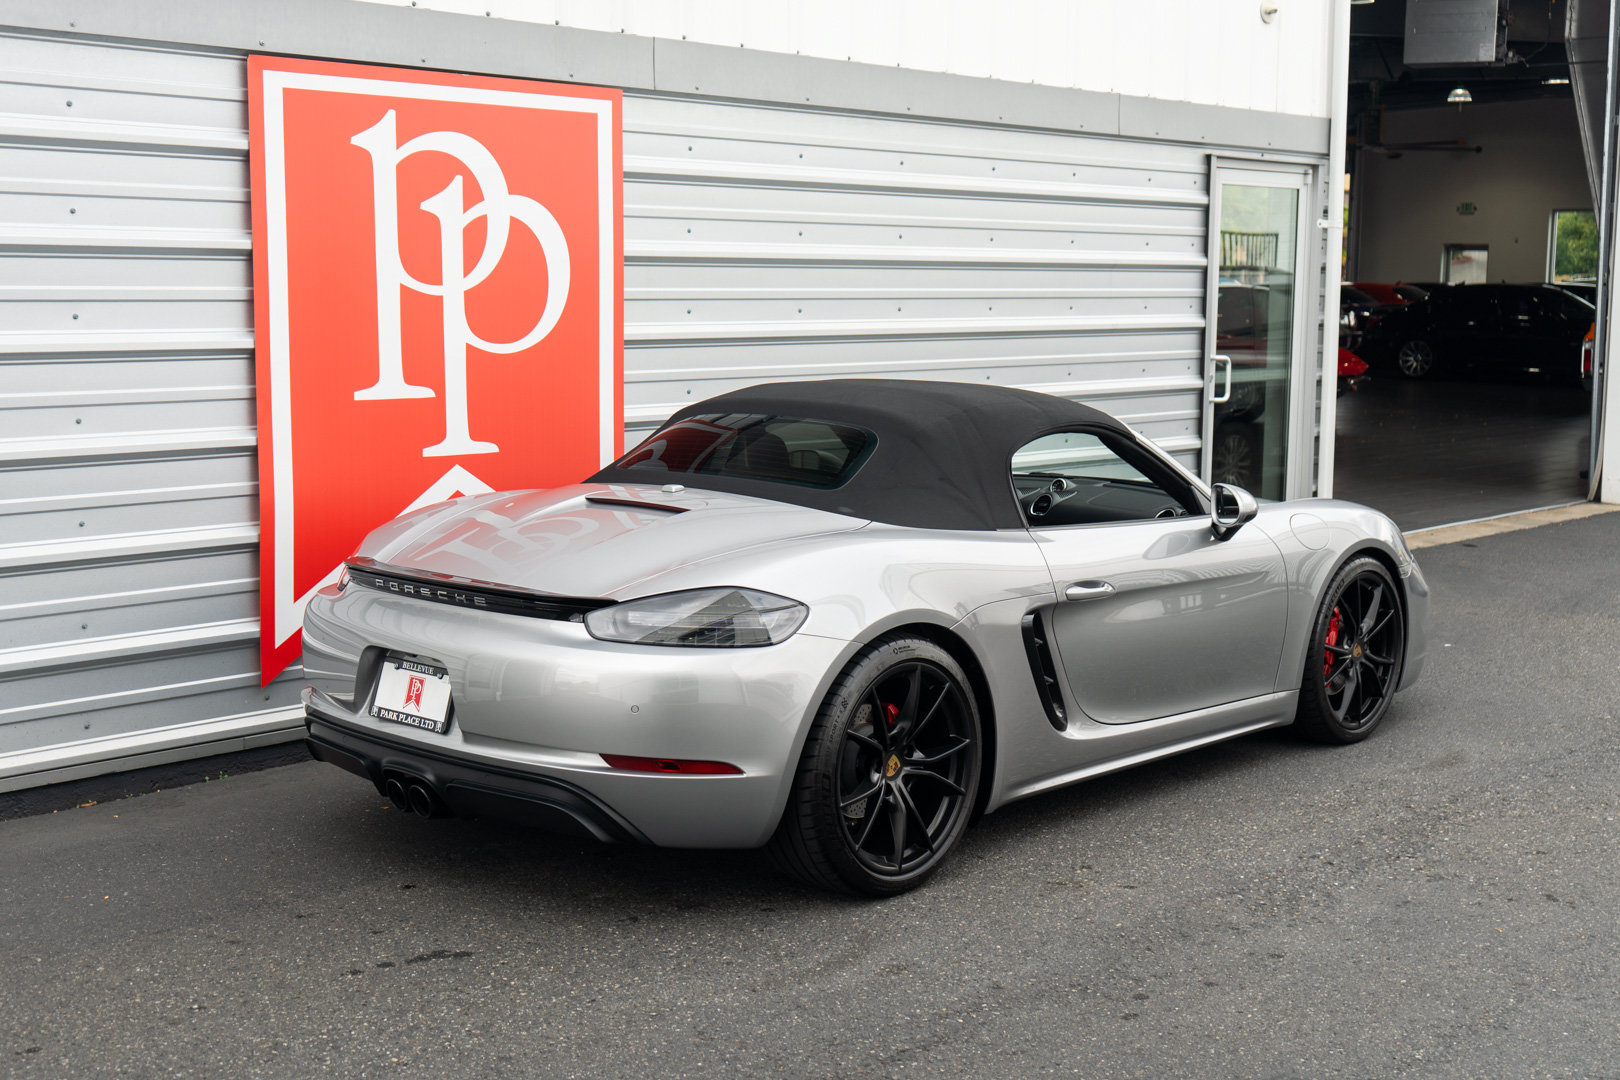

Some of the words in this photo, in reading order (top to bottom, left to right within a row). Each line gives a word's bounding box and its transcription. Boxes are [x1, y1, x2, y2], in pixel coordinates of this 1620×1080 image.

[375, 578, 487, 607] PORSCHE
[402, 661, 435, 675] BELLEVUE
[380, 709, 398, 721] PARK
[398, 713, 420, 726] PLACE
[420, 719, 435, 729] LTD
